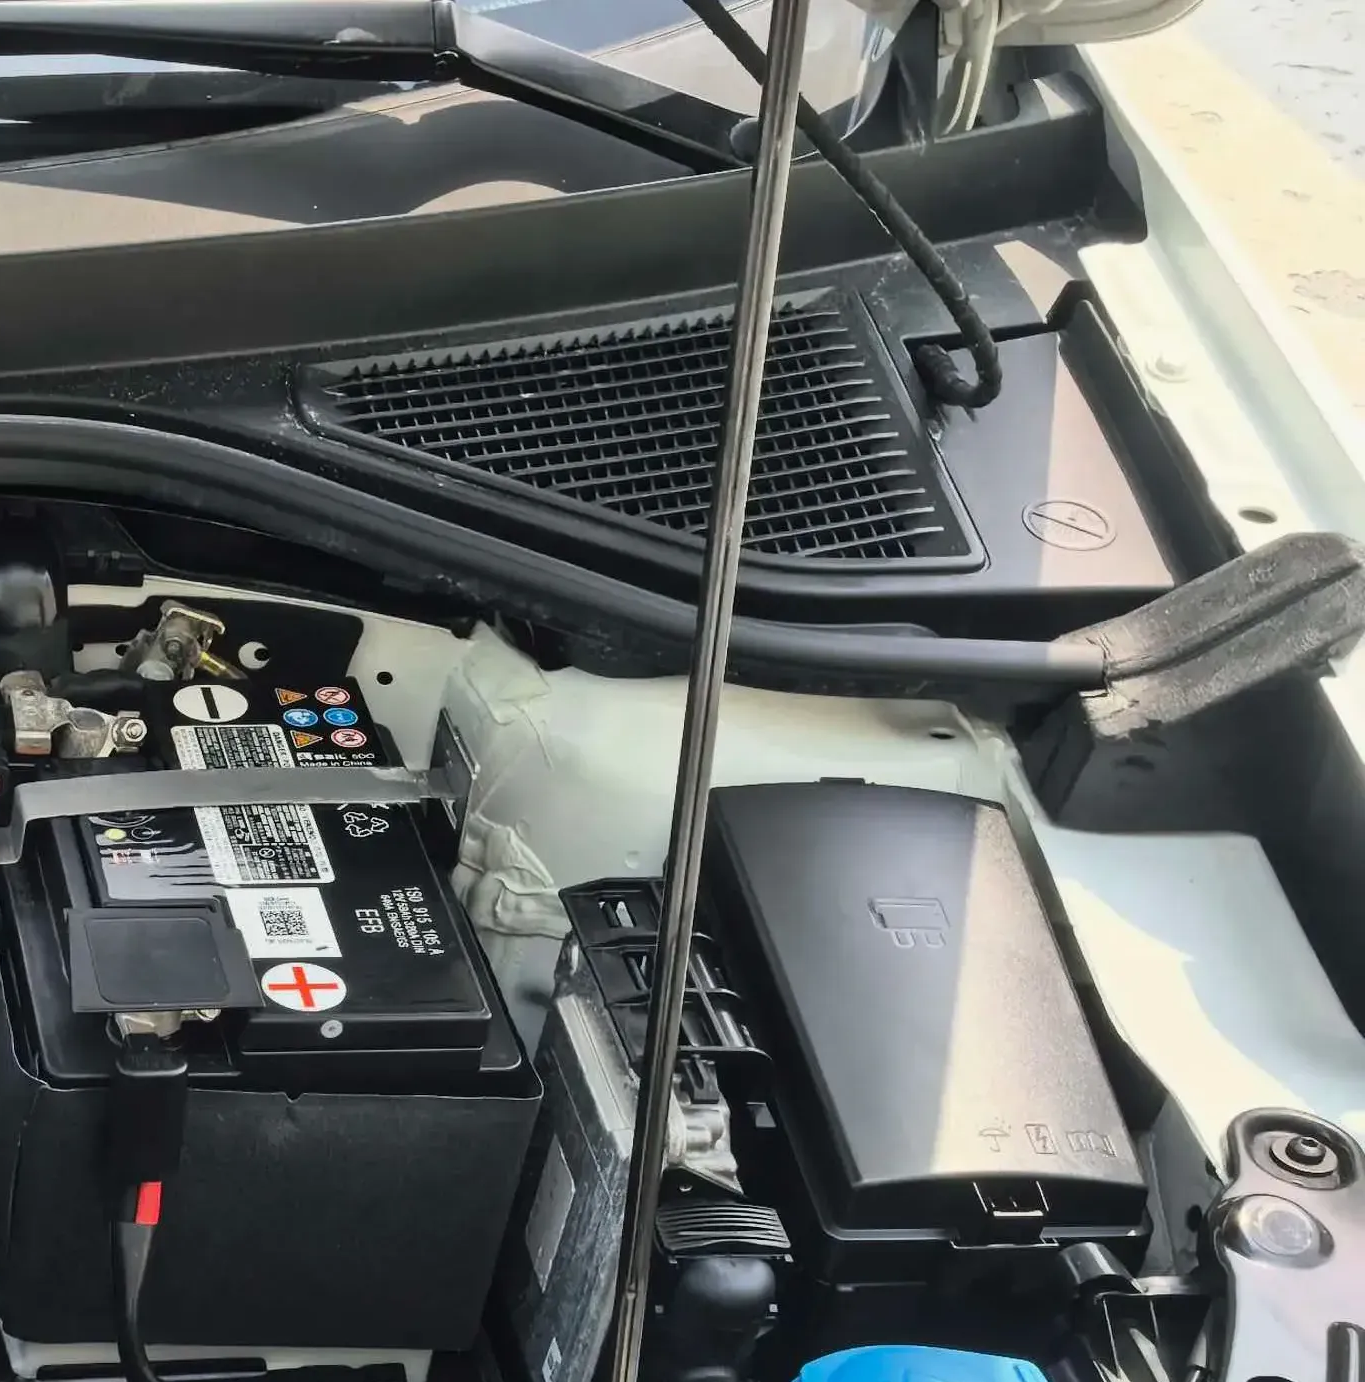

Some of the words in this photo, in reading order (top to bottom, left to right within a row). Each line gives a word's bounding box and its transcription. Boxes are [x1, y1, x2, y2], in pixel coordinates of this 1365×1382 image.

[299, 760, 329, 768] Made
[354, 909, 385, 934] EFB
[412, 907, 433, 923] 915
[411, 940, 426, 954] DIN
